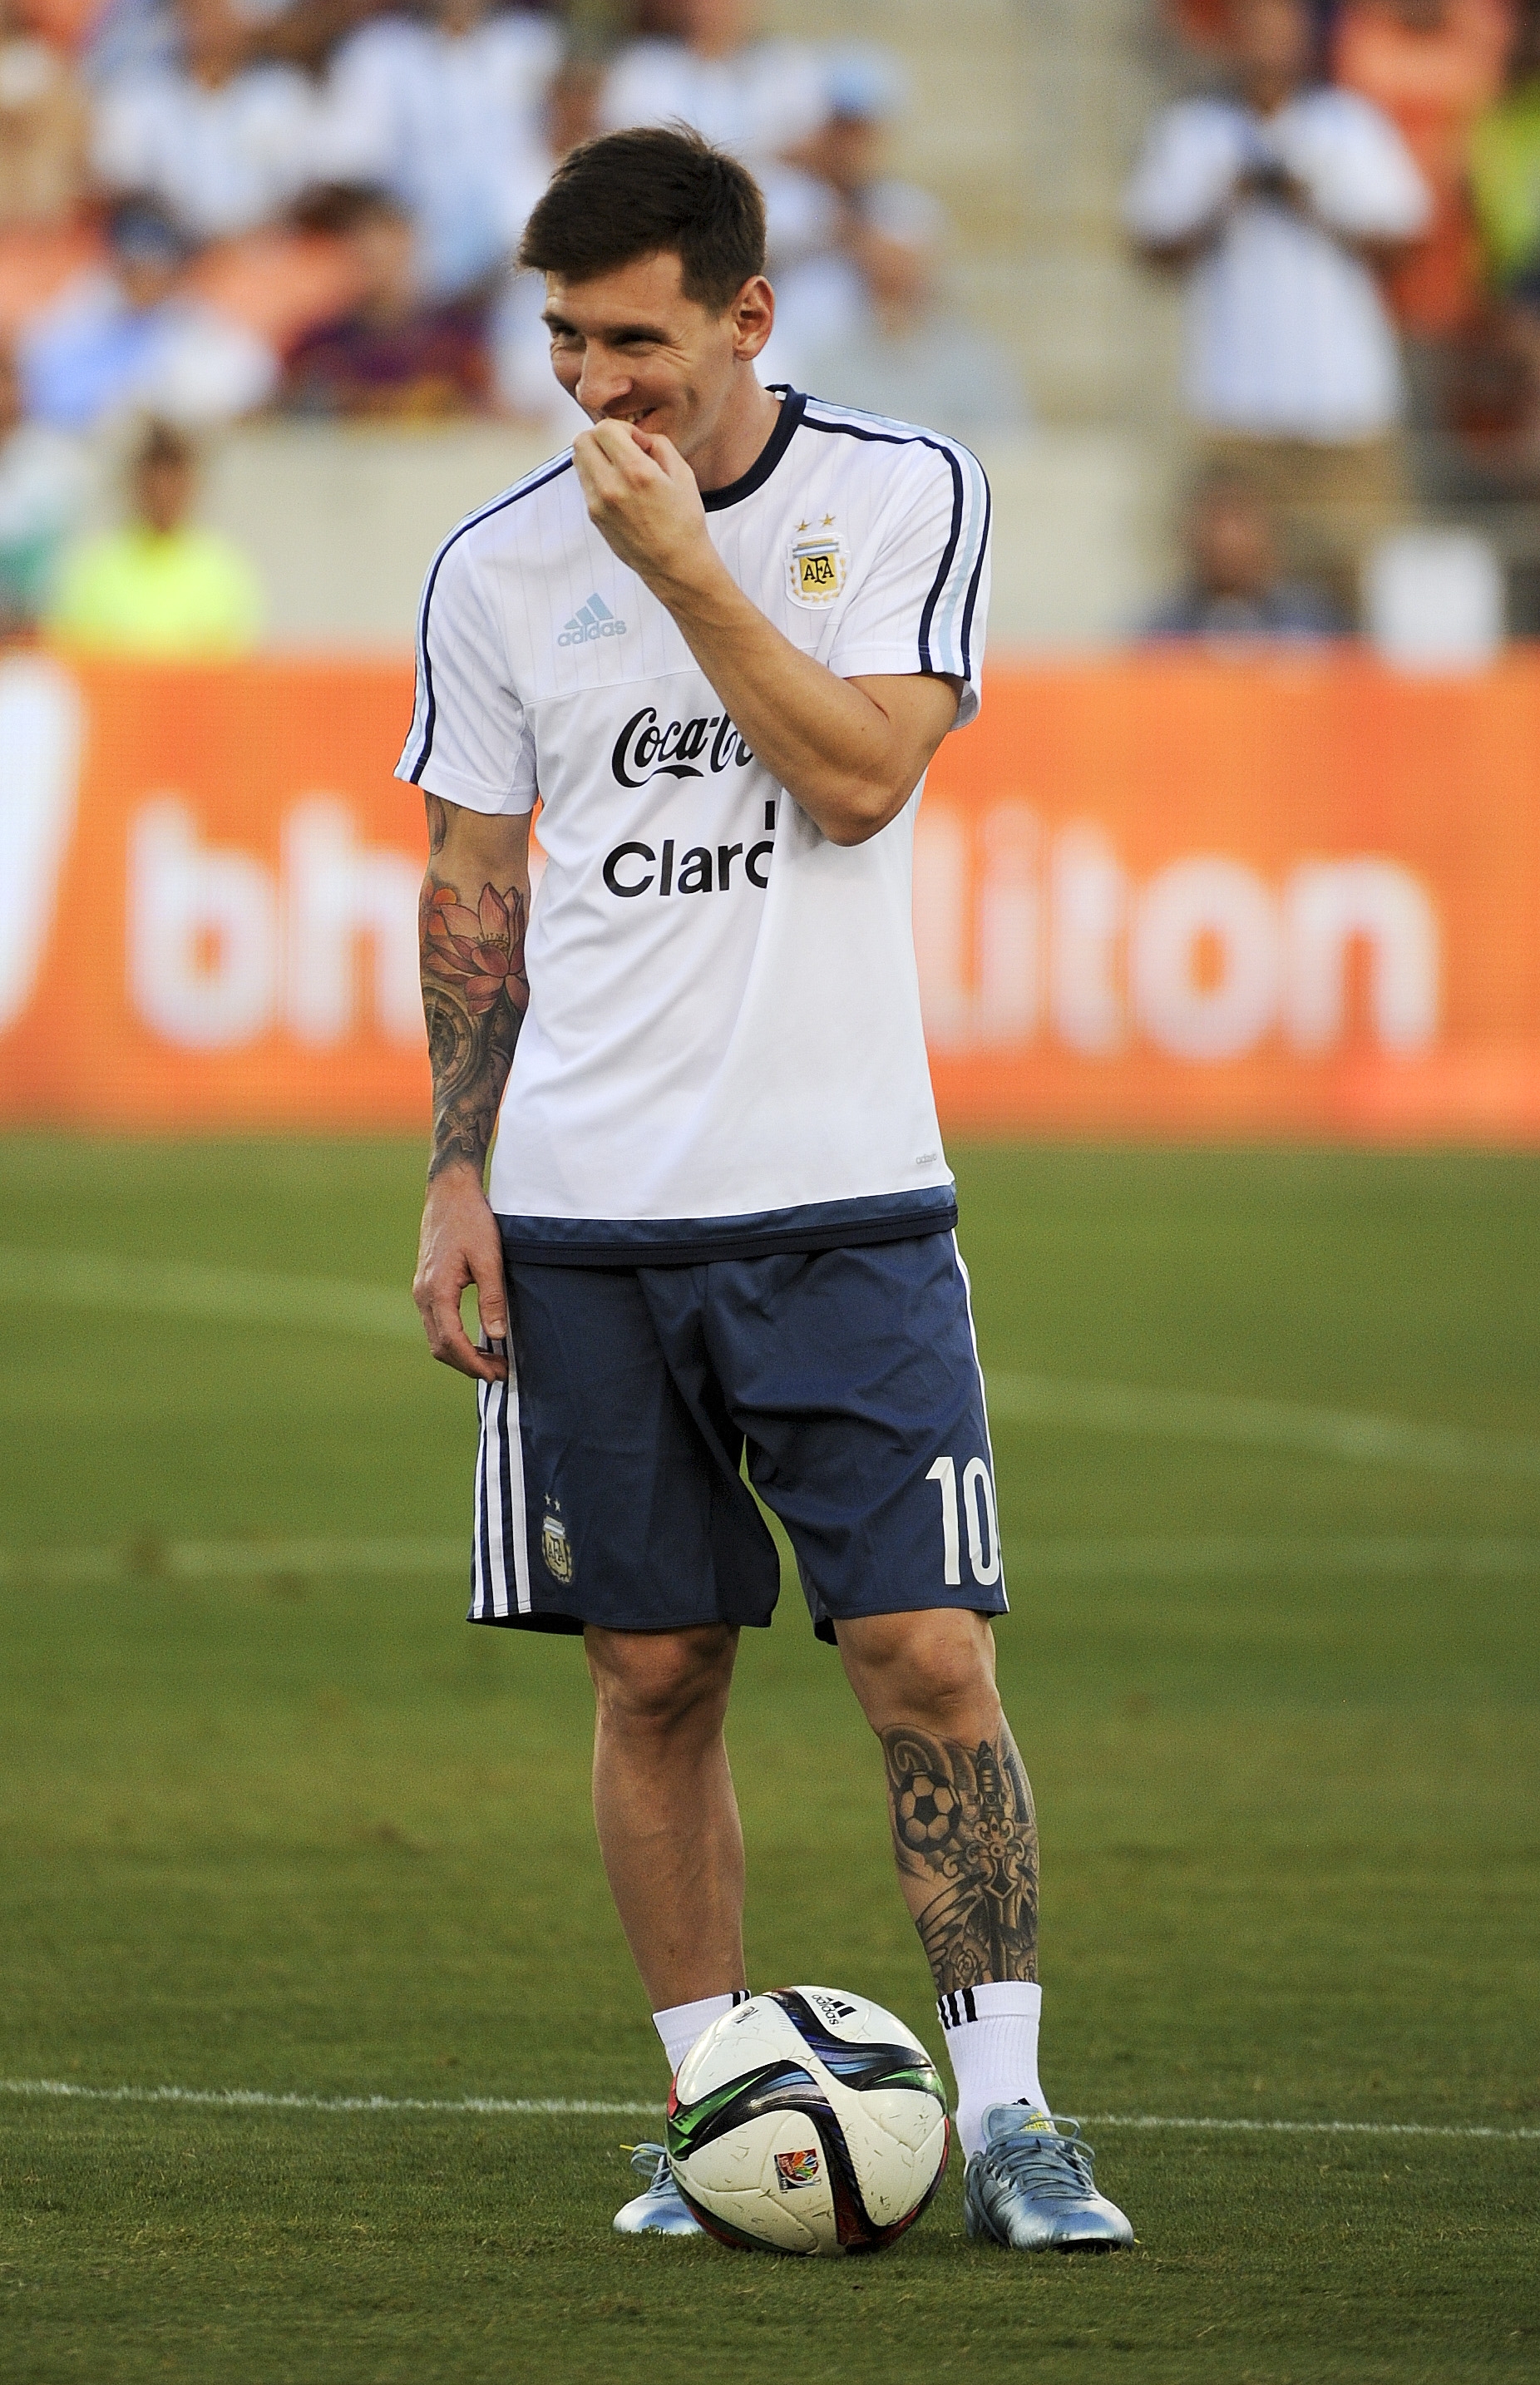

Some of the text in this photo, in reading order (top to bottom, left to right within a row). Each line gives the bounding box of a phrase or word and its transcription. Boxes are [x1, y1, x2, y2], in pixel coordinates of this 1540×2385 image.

[802, 556, 834, 584] AFA
[558, 620, 626, 646] adidas
[925, 1456, 1000, 1586] 10
[812, 1994, 839, 2024] adidas
